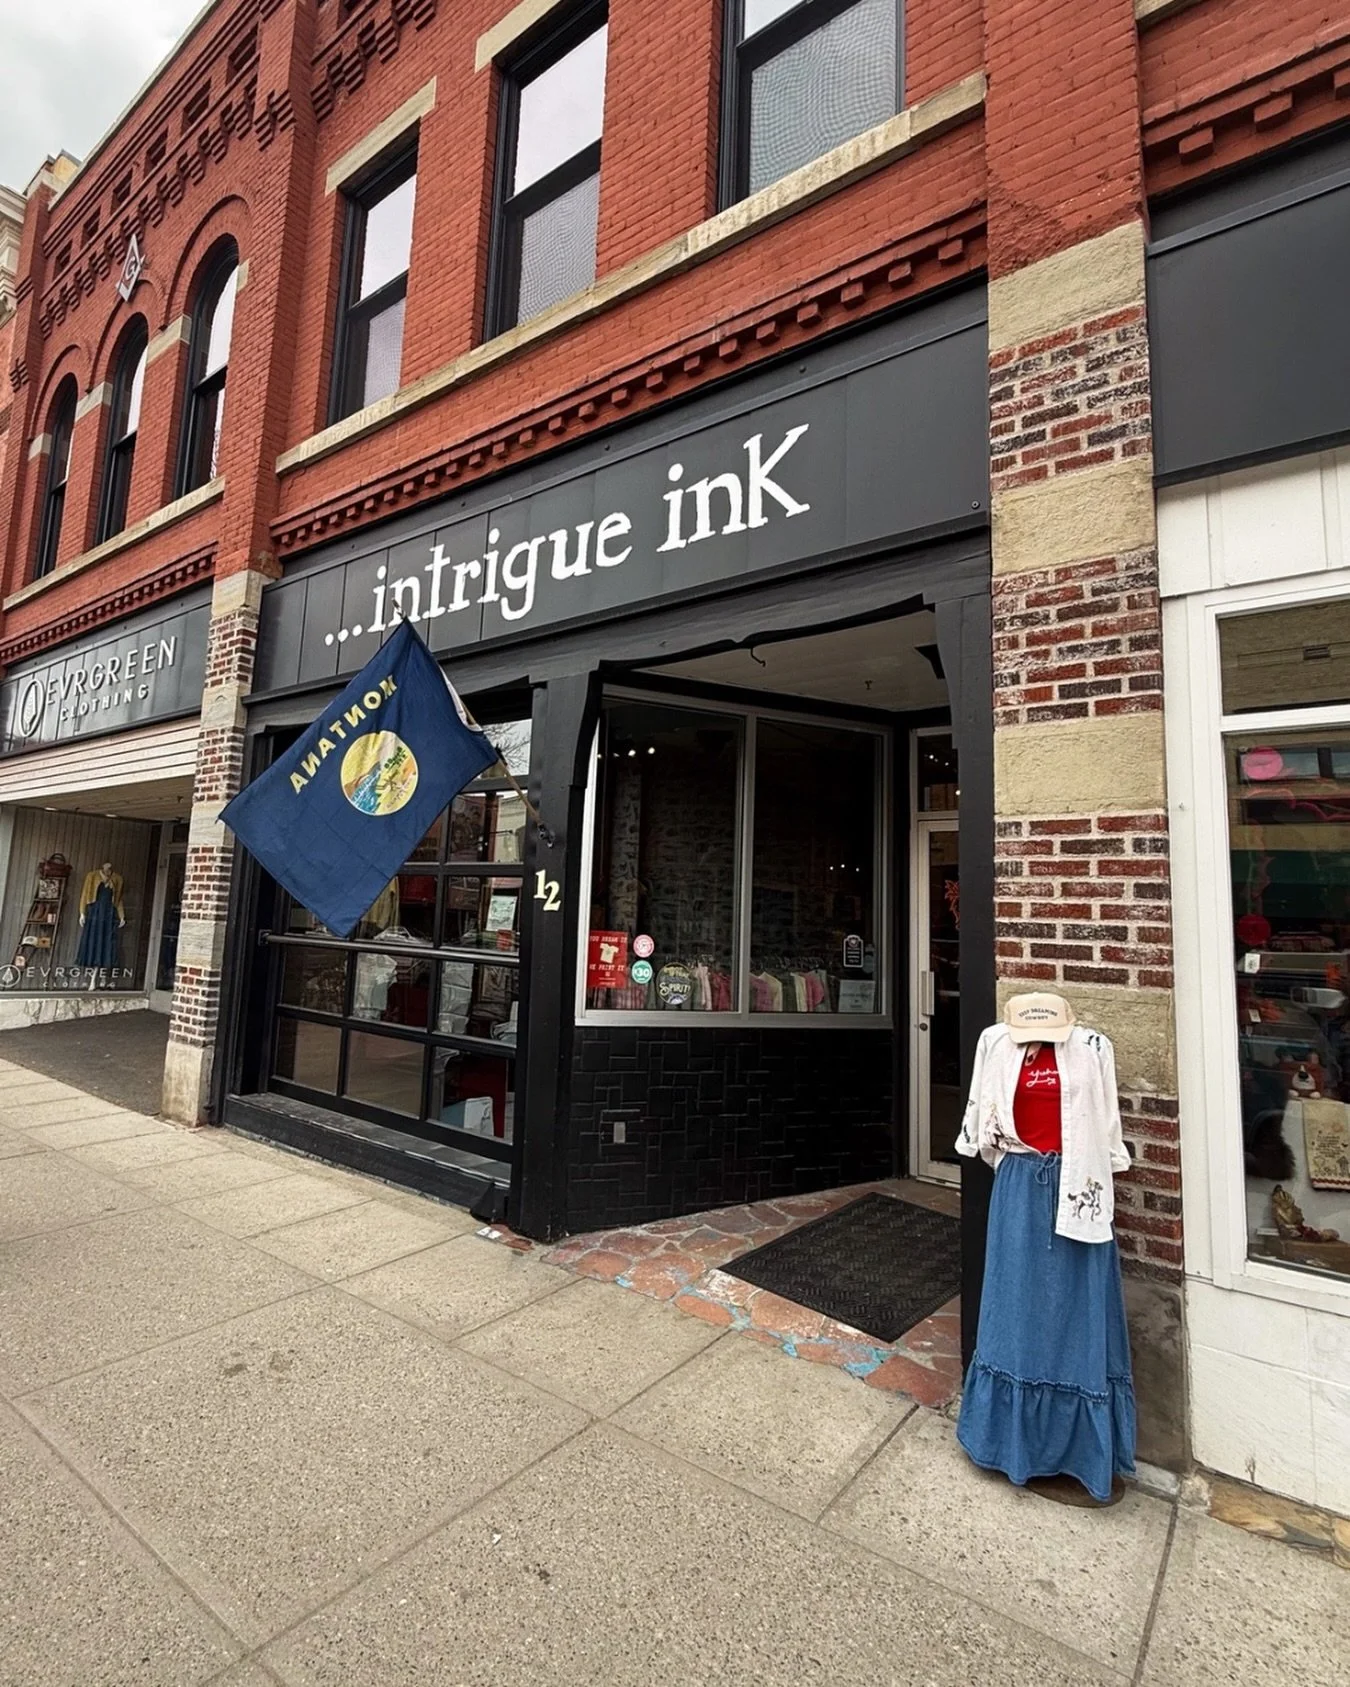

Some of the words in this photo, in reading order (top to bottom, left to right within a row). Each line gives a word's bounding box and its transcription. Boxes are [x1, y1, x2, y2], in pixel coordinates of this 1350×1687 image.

[47, 636, 178, 705] EVRGREEN
[61, 684, 149, 721] CLOTHING
[533, 869, 561, 911] 12
[26, 966, 133, 978] EVRGREEN
